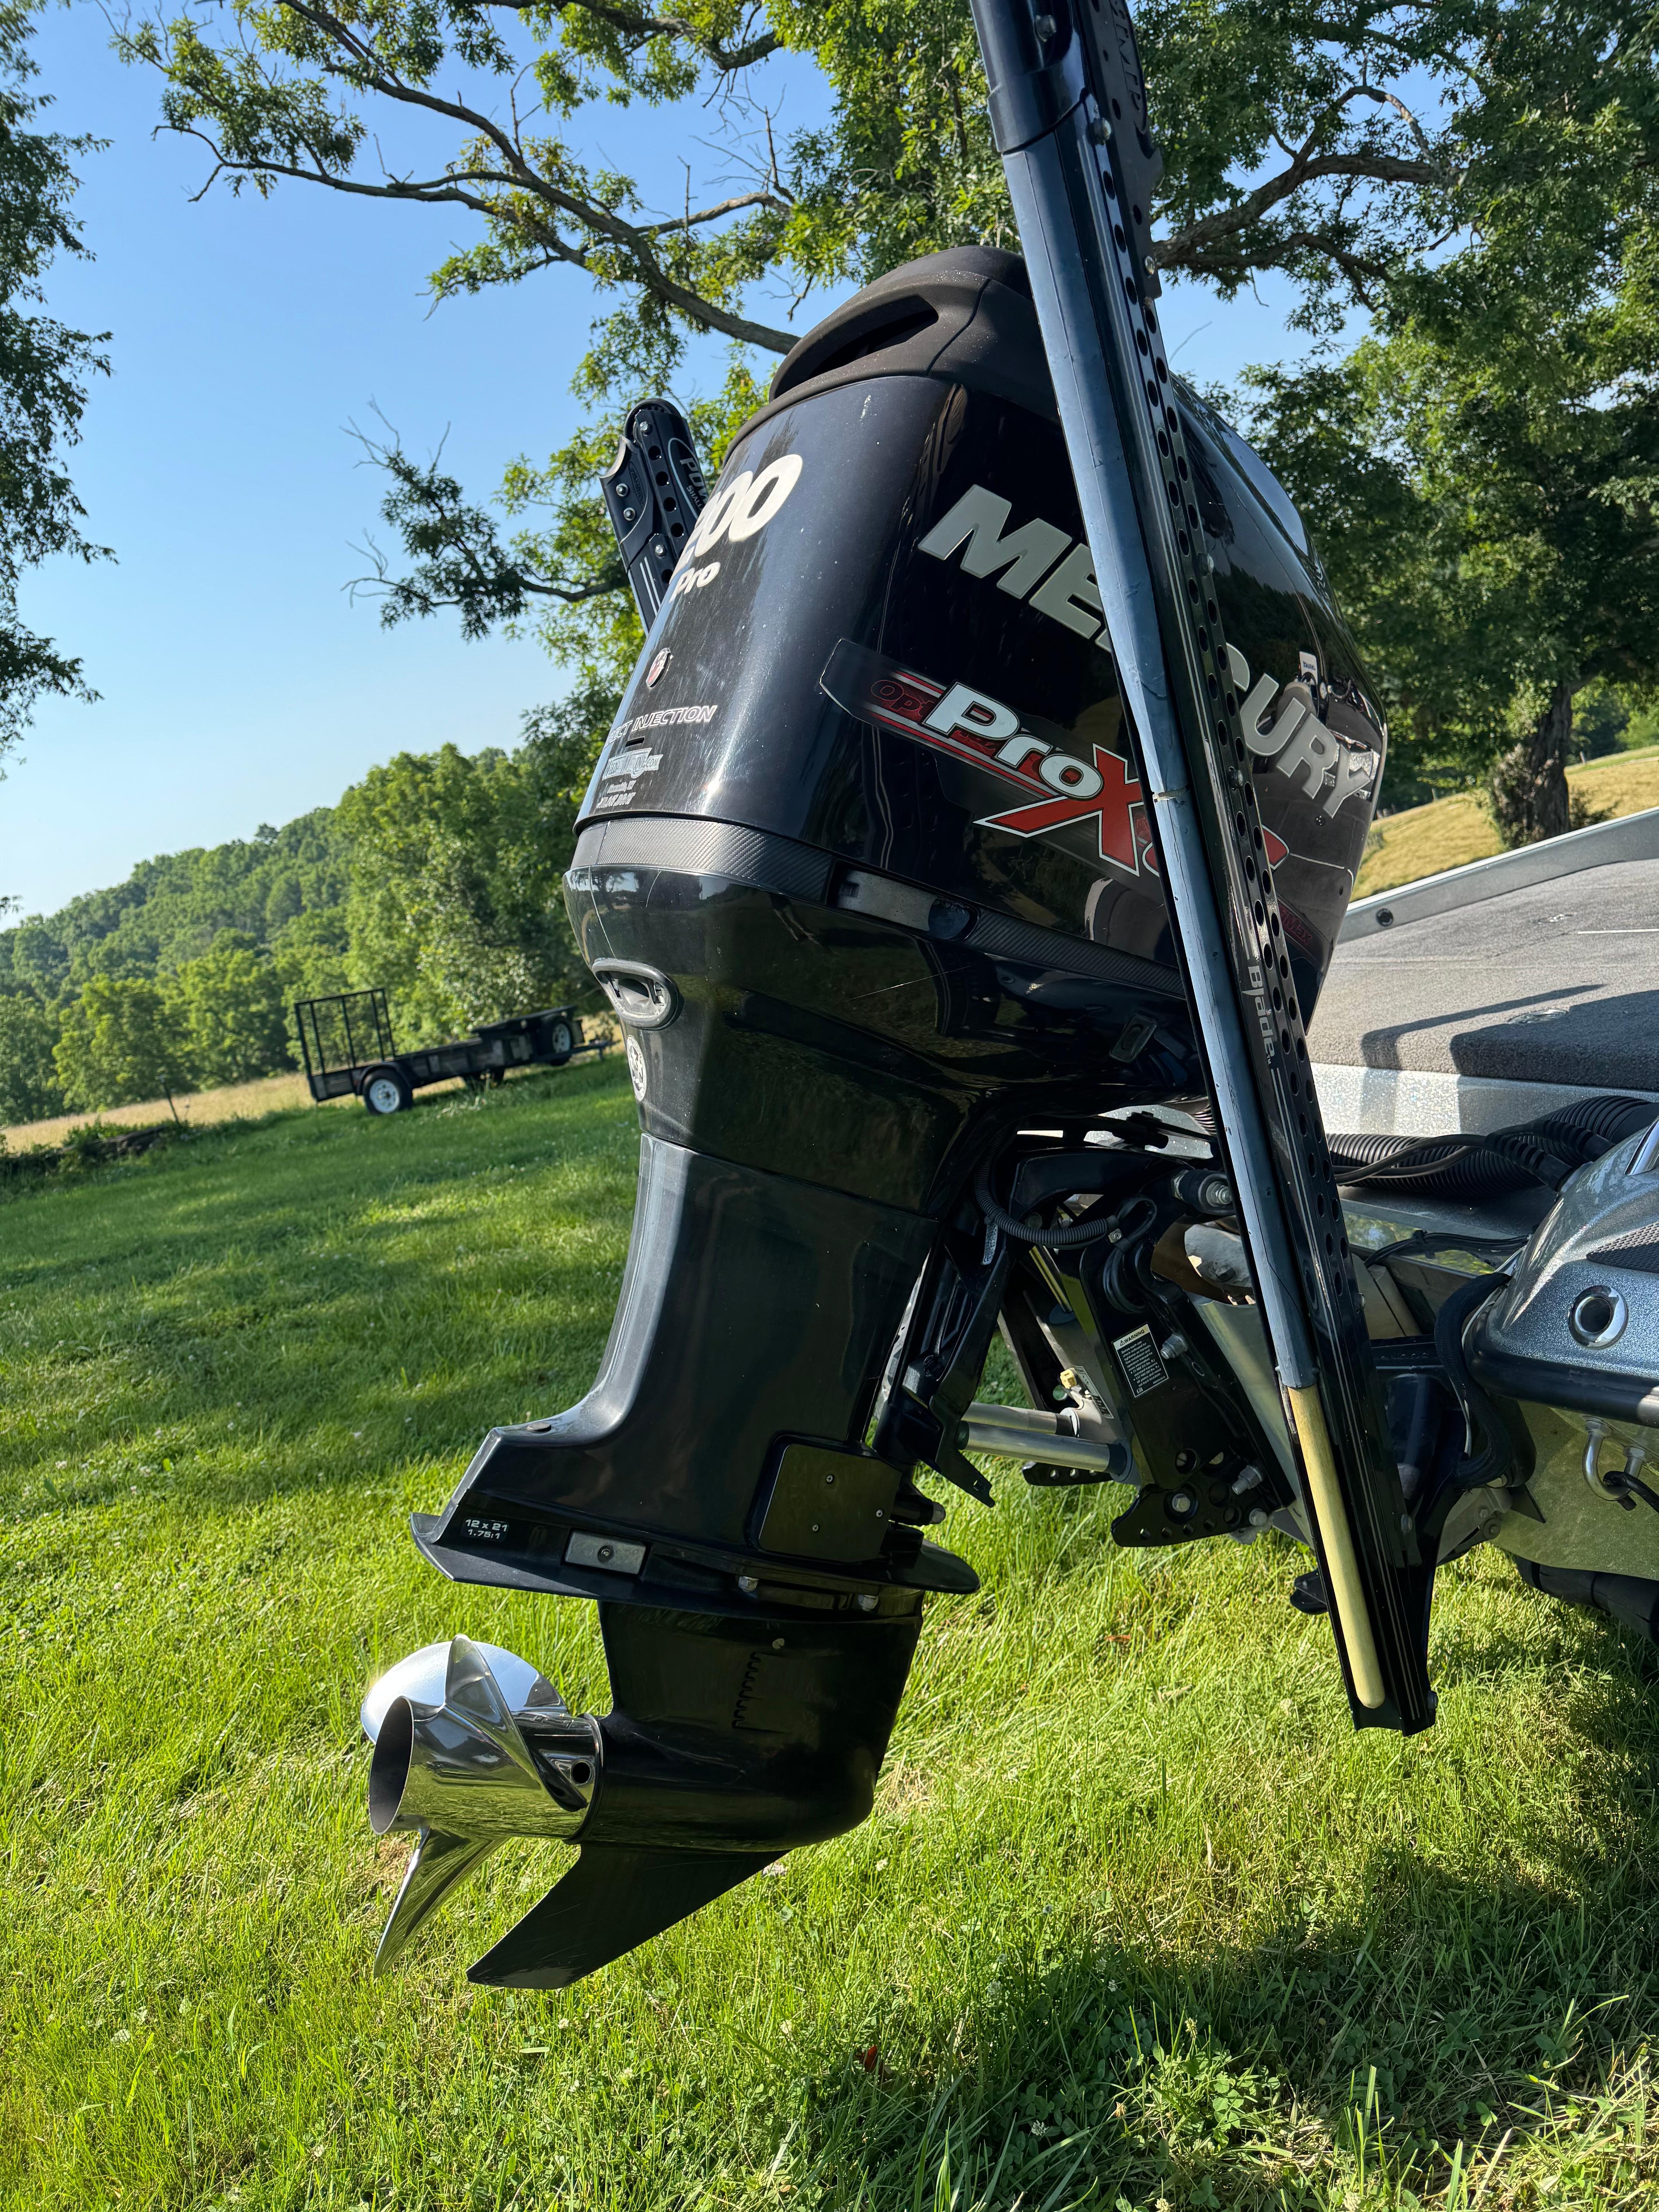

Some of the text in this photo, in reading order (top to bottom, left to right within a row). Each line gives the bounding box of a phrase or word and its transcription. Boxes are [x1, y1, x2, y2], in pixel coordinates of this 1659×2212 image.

[669, 562, 721, 604] Pro
[918, 484, 1371, 818] MEURY
[631, 704, 718, 732] INJECTION
[1123, 1329, 1145, 1343] WARNING
[465, 1519, 480, 1528] 12
[492, 1523, 508, 1532] 21
[468, 1529, 500, 1539] 1.75:1
